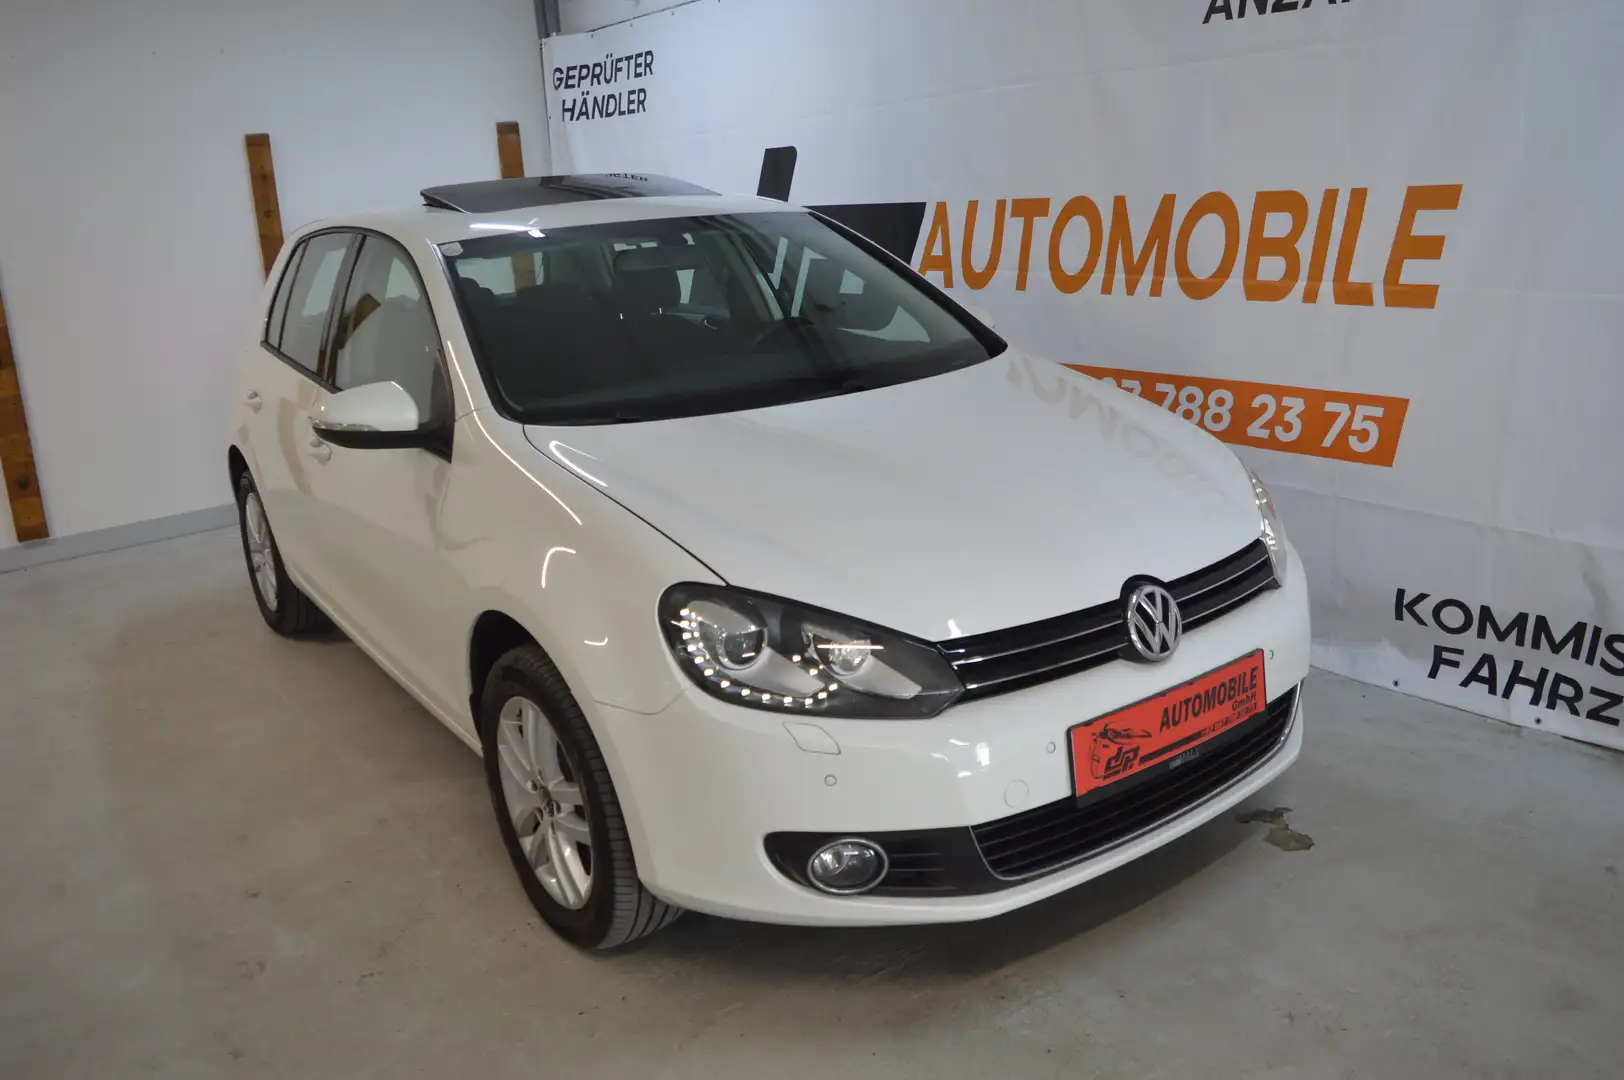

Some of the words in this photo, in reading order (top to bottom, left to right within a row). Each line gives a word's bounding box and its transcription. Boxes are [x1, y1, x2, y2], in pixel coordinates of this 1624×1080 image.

[553, 50, 654, 91] GEPRÜFTER
[562, 88, 647, 122] HÄNDLER
[918, 184, 1463, 310] AUTOMOBILE
[1155, 382, 1234, 432] 788
[1247, 394, 1305, 443] 23
[1321, 402, 1384, 453] 75
[1395, 587, 1624, 677] KOMMIS
[1159, 666, 1258, 733] AUTOMOBILE
[1427, 644, 1624, 727] FAHRZ
